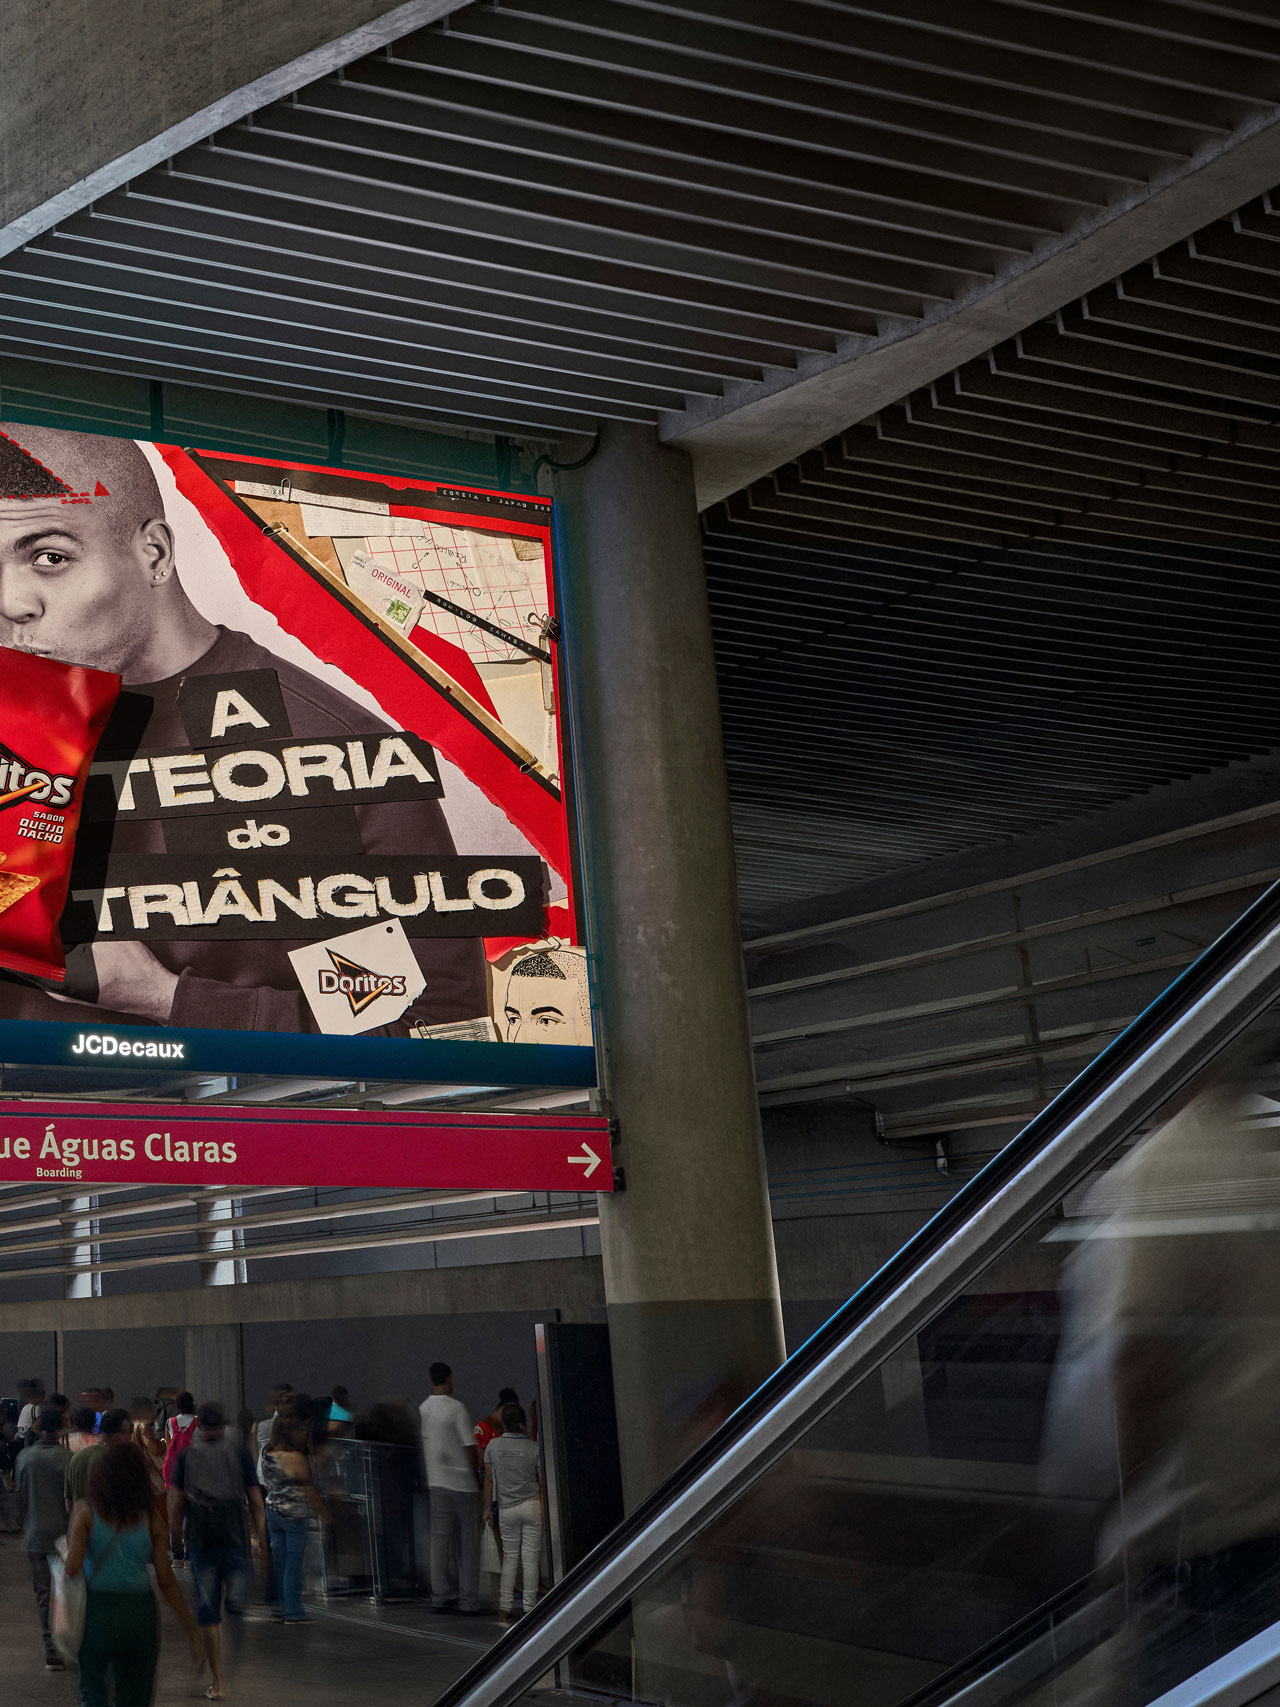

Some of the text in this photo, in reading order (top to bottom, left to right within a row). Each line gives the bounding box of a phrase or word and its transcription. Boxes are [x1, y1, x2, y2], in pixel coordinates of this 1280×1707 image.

[371, 568, 412, 599] ORIGINAL
[210, 688, 271, 739] A
[89, 737, 436, 811] TEORIA
[18, 817, 65, 834] QUEIJO
[32, 810, 65, 823] SABOR
[16, 827, 63, 844] NACHO
[227, 819, 291, 850] do
[73, 867, 526, 932] TRIÂNGULO
[318, 969, 407, 997] Doritos
[71, 1034, 185, 1059] JCDecaux
[39, 1123, 136, 1167] Águas
[144, 1133, 238, 1164] Claras
[36, 1167, 83, 1180] Boarding
